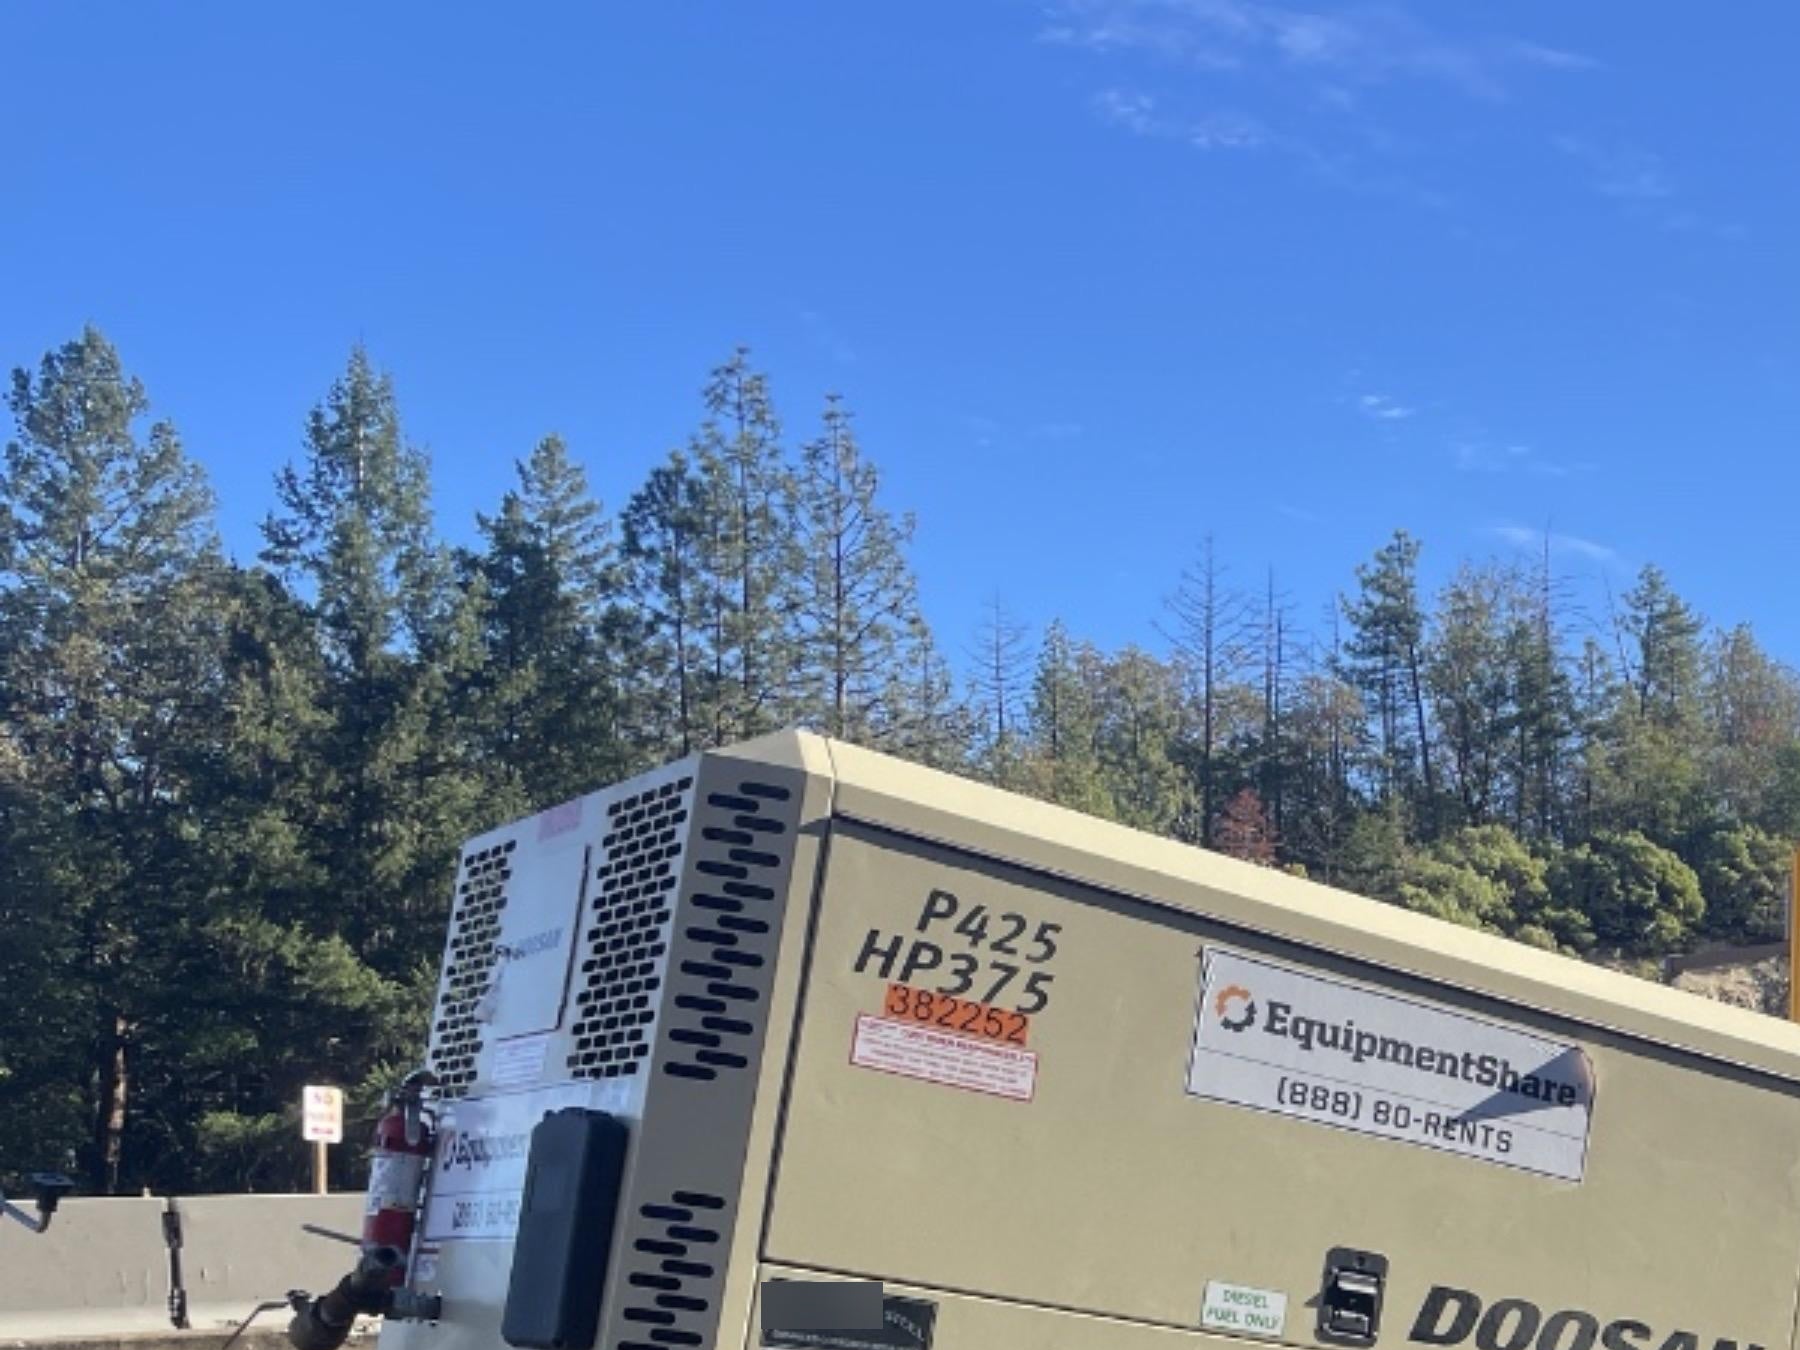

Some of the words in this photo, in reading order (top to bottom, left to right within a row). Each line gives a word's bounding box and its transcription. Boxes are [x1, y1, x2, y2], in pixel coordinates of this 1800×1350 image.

[915, 888, 1062, 963] P425
[854, 928, 1055, 1014] HP375
[889, 984, 1029, 1045] 382252
[1262, 1000, 1577, 1107] EquipmentShare
[1276, 1076, 1363, 1120] (888)
[1372, 1099, 1514, 1154] 80-RENTS
[1205, 1305, 1240, 1324] FUEL
[1244, 1312, 1281, 1330] ONLY
[1223, 1289, 1269, 1309] DIESEL
